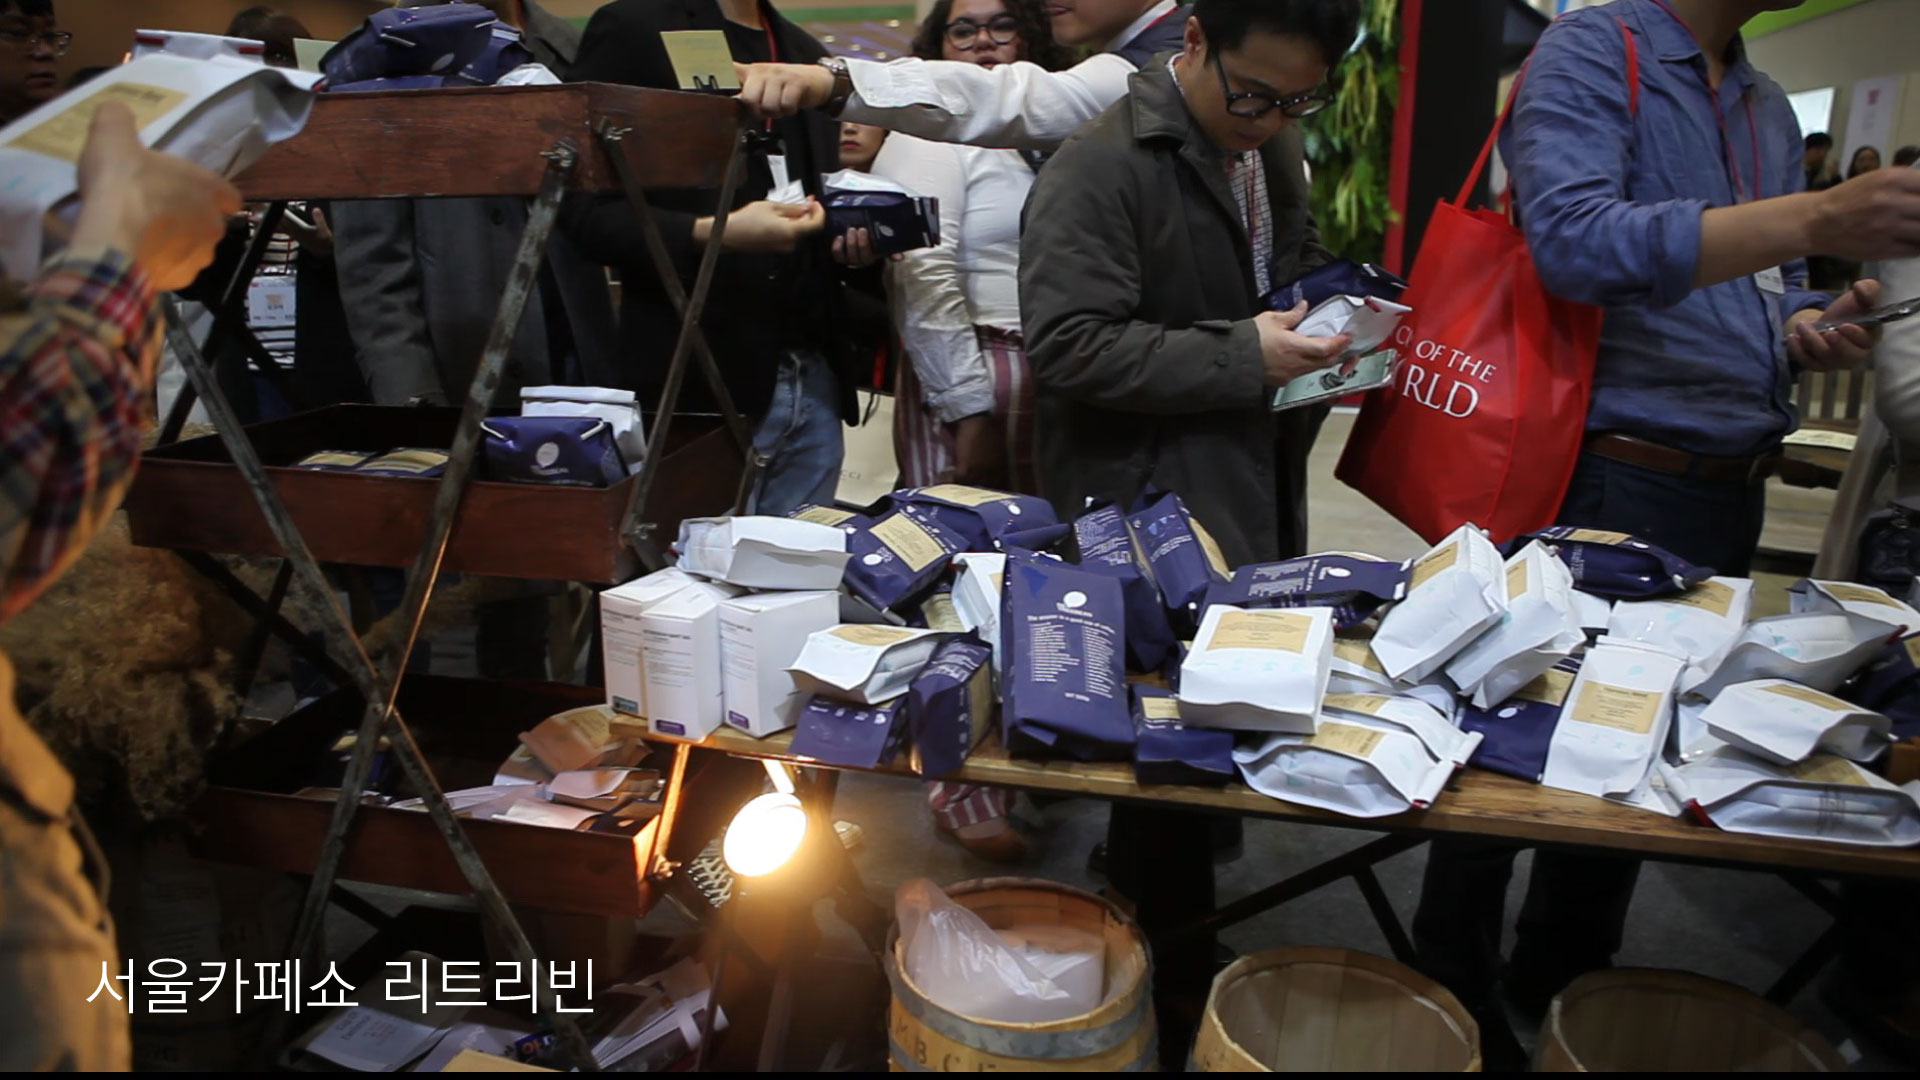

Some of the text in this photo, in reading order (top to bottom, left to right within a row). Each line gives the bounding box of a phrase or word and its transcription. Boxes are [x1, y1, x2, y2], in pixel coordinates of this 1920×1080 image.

[1416, 339, 1447, 361] OF
[1448, 348, 1497, 383] THE
[1394, 358, 1479, 418] RLD
